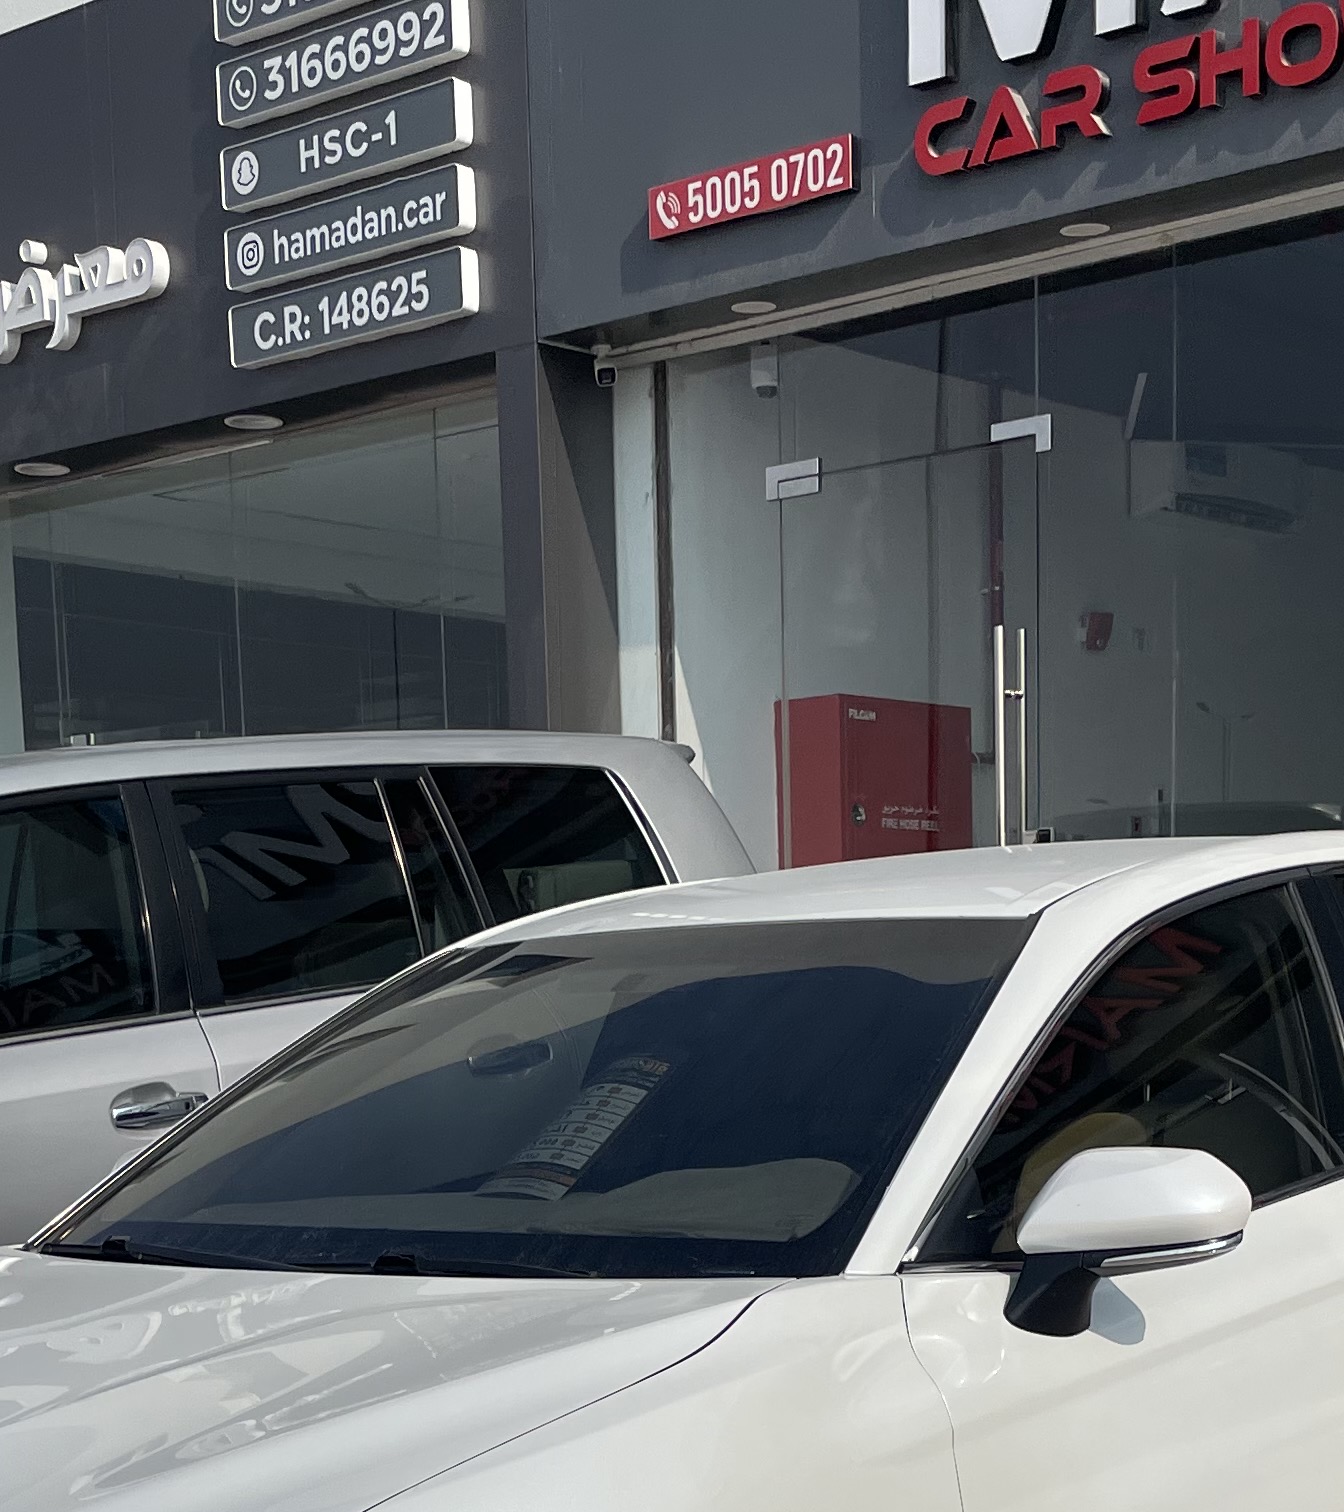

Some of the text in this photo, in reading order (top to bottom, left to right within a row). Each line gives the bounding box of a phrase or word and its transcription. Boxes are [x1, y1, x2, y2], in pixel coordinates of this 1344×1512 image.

[262, 2, 446, 100] 31666992
[298, 110, 398, 173] HSC-1
[913, 64, 1112, 177] CAR
[686, 143, 845, 219] 5005 0702
[272, 191, 447, 264] hamadan.car
[252, 269, 431, 350] C.R: 148625
